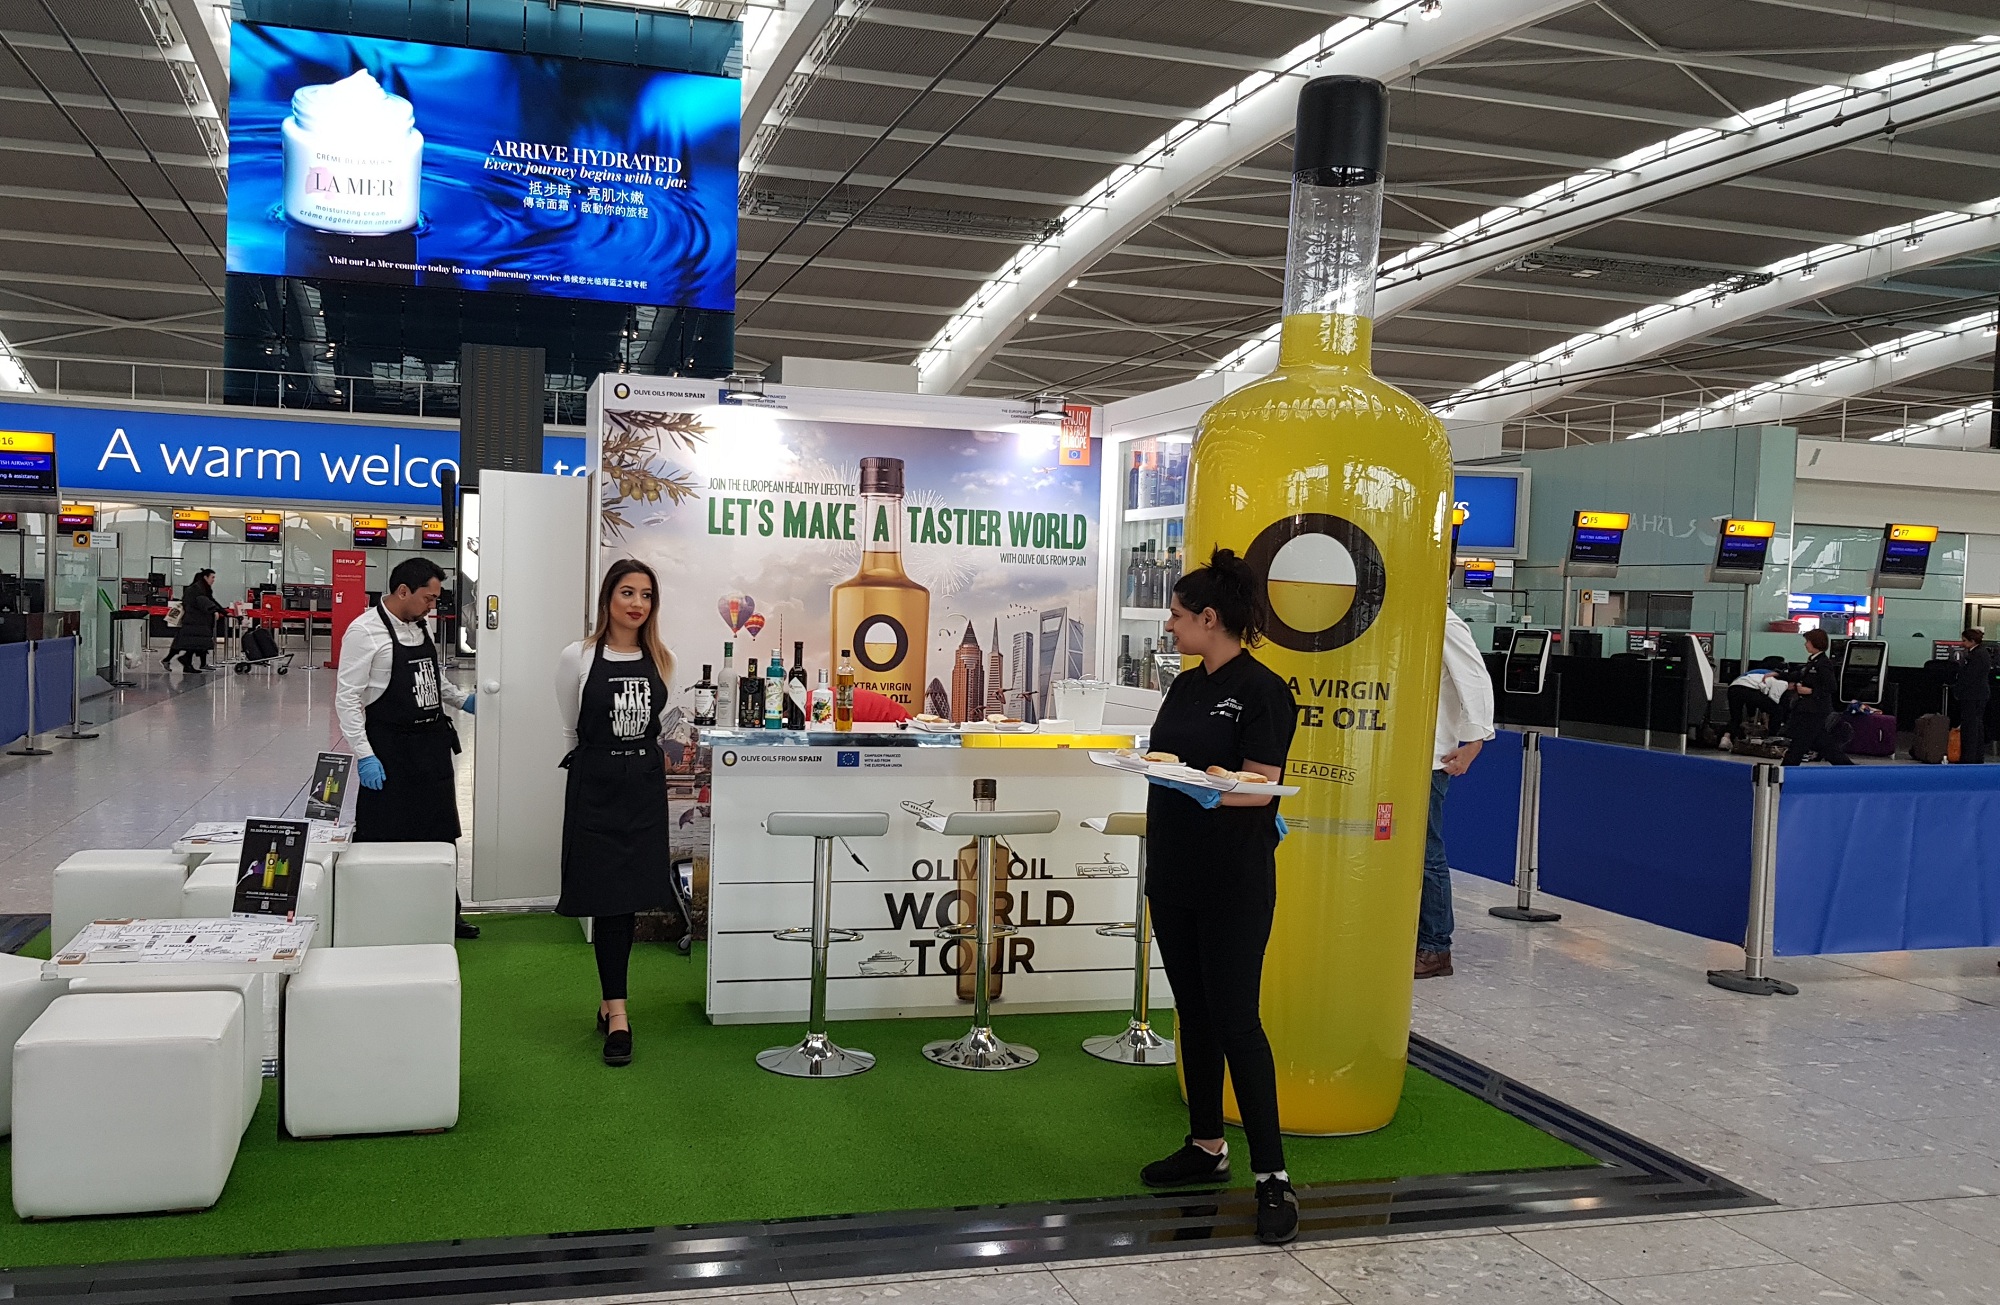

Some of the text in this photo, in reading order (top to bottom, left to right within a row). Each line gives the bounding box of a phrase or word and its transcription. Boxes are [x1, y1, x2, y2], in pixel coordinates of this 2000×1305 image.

[490, 140, 682, 174] ARRIVE HYDRATED
[483, 156, 688, 190] Every journey begins with a jar.
[313, 172, 394, 197] LA MER
[315, 204, 386, 218] moisturizing cream
[375, 218, 403, 226] intense
[328, 255, 348, 266] Visit
[348, 258, 365, 267] our
[366, 258, 376, 268] La
[377, 259, 394, 269] Mer
[395, 262, 427, 272] counter
[428, 264, 450, 275] today
[452, 265, 465, 275] for
[471, 267, 533, 282] complimentary
[533, 273, 562, 282] service
[634, 388, 705, 400] OLIVE OILS FROM SPAIN
[97, 428, 141, 473] A
[160, 442, 300, 481] warm
[707, 478, 856, 497] JOIN THE EUROPEAN HEALTHY LIFESTYLE
[708, 496, 1087, 550] LET'S MAKE A TASTIER WORLD
[1000, 552, 1087, 567] WITH OLIVE OILS FROM SPAIN
[880, 682, 912, 692] VIRGIN
[1309, 677, 1391, 701] VIRGIN
[614, 692, 652, 711] MAKE
[613, 709, 651, 722] TASTIER
[1332, 707, 1387, 731] OIL
[612, 720, 650, 737] WORLD
[777, 755, 797, 763] FROM
[798, 755, 822, 763] SPAIN
[1292, 762, 1357, 782] LEADERS
[912, 858, 1053, 881] OLIV OIL
[884, 889, 1075, 932] WORLD
